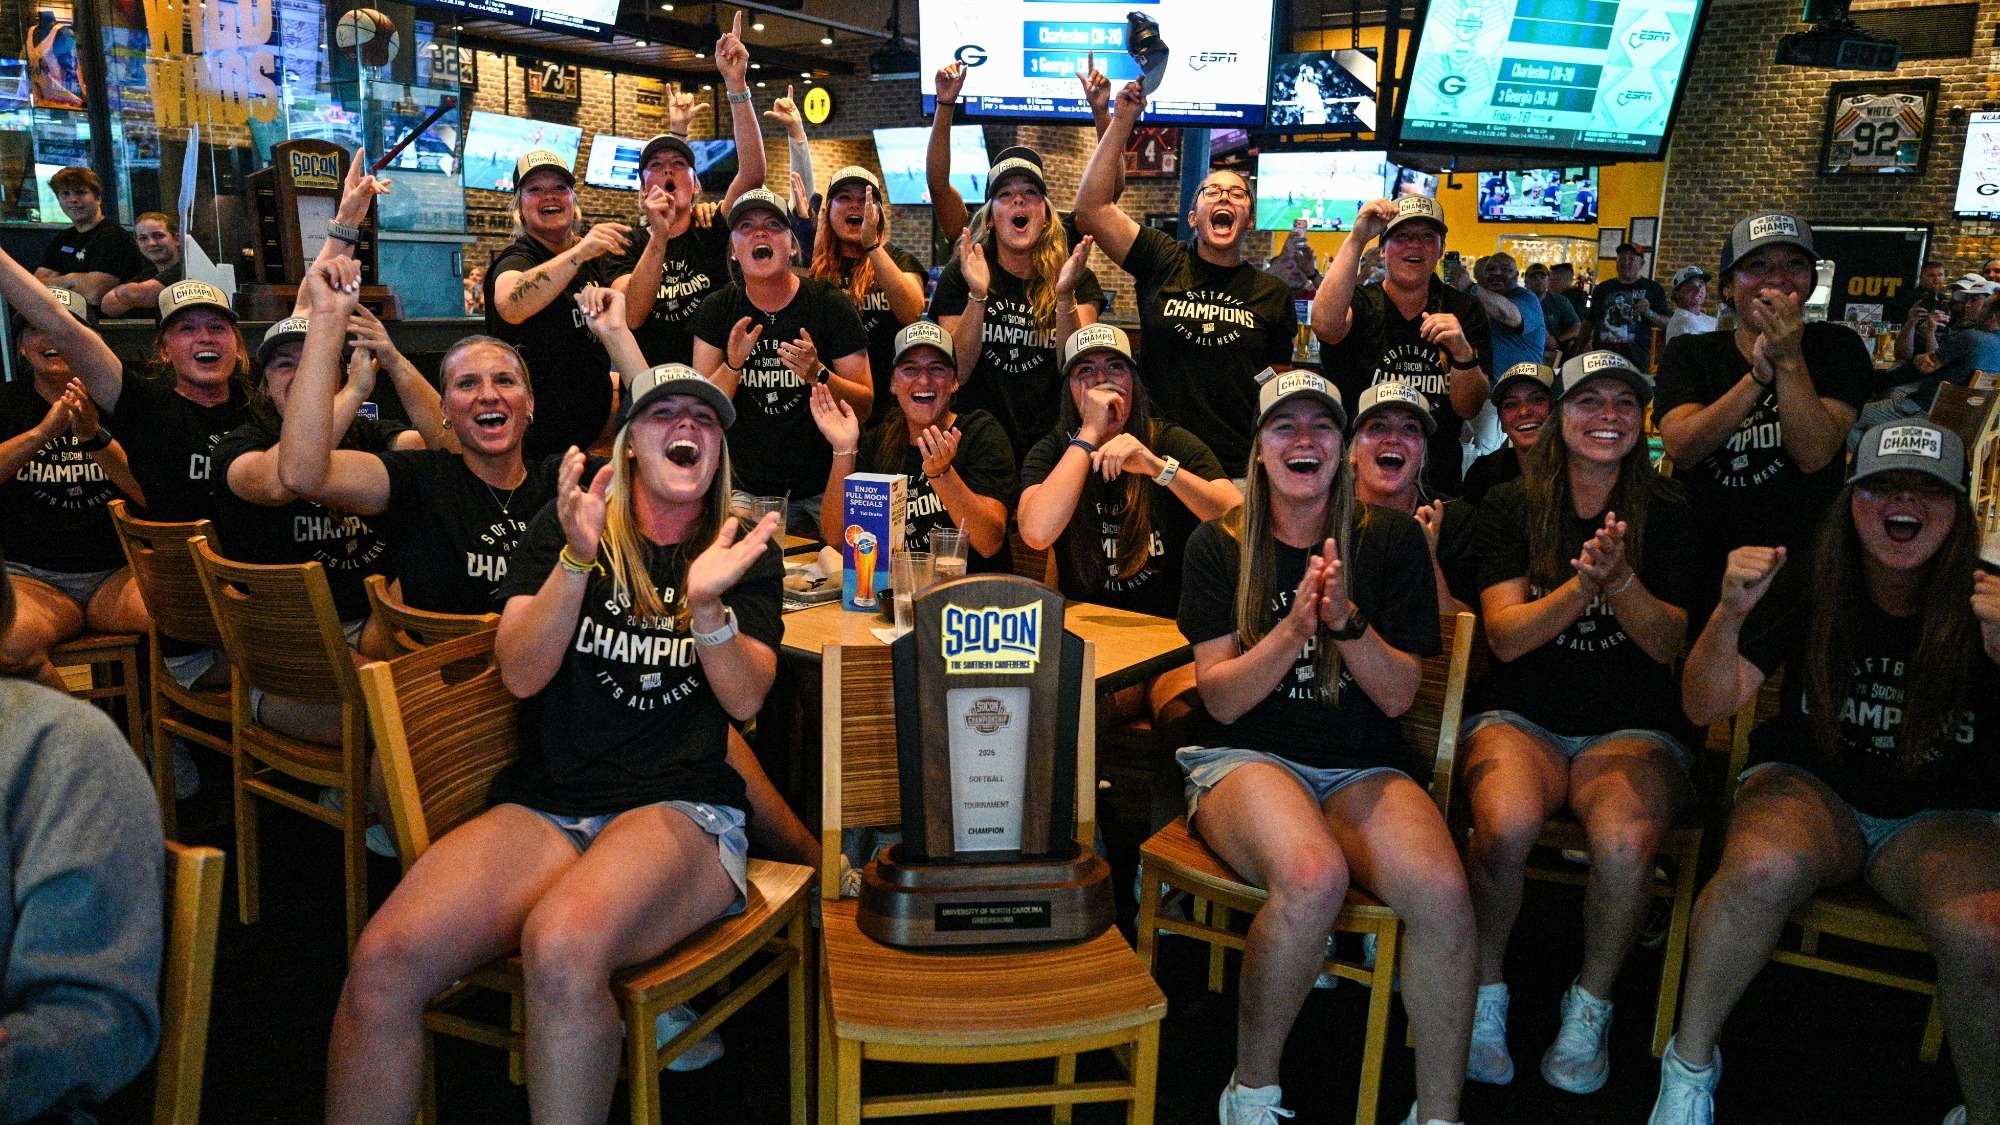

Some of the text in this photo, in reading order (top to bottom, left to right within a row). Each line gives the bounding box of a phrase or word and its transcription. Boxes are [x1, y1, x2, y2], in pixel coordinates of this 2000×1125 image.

[1639, 30, 1671, 42] ESPN
[1200, 53, 1238, 62] ESPN
[143, 50, 279, 127] WINGS
[1866, 106, 1894, 117] WHITE
[1853, 122, 1900, 156] 92
[1401, 202, 1431, 213] CHAMPS
[1753, 223, 1795, 235] CHAMPS
[1848, 276, 1902, 297] OUT
[176, 289, 213, 299] CHAMPS
[665, 297, 701, 322] ALL HERE
[1163, 299, 1255, 329] CHAMPIONS
[908, 328, 939, 339] CHAMPS
[982, 322, 1057, 349] HAMPIONS
[1080, 333, 1113, 346] CHAMPS
[1174, 323, 1241, 347] IT'S ALL HERE
[986, 349, 1044, 373] IT'S ALL HERE
[1383, 344, 1441, 368] SOFTBALL
[1403, 361, 1423, 372] SOCON
[1281, 378, 1324, 391] CHAMPS
[1380, 390, 1418, 402] CHAMPS
[1883, 438, 1937, 453] CHAMPS
[61, 451, 83, 462] SOCON
[16, 460, 110, 483] CHAMPIO
[1722, 475, 1747, 487] ALL
[1752, 458, 1785, 485] HERE
[854, 485, 879, 494] ENJOY
[34, 488, 114, 509] IT'S ALL HERE
[845, 491, 888, 501] FULL MOON
[849, 498, 883, 508] SPECIALS
[849, 507, 856, 516] $
[481, 519, 527, 545] SOFTB
[904, 539, 921, 550] ALL
[313, 549, 339, 568] IT'S
[361, 539, 387, 564] HERE
[1104, 580, 1123, 591] ALL
[641, 615, 675, 632] SCON
[576, 616, 697, 668] CHAMPIO
[1570, 630, 1628, 652] ALL HER
[951, 660, 1031, 670] THE SOUTHERN CONFERENCE
[596, 671, 700, 711] IT'S ALL HERE
[1288, 686, 1314, 699] ALL
[978, 749, 996, 757] 2026
[968, 775, 1005, 783] SOFTBALL
[963, 800, 1010, 810] TOURNAMENT
[967, 826, 1005, 835] CHAMPION
[942, 906, 1043, 917] UNIVERSITY OF NORTH CAROLINA
